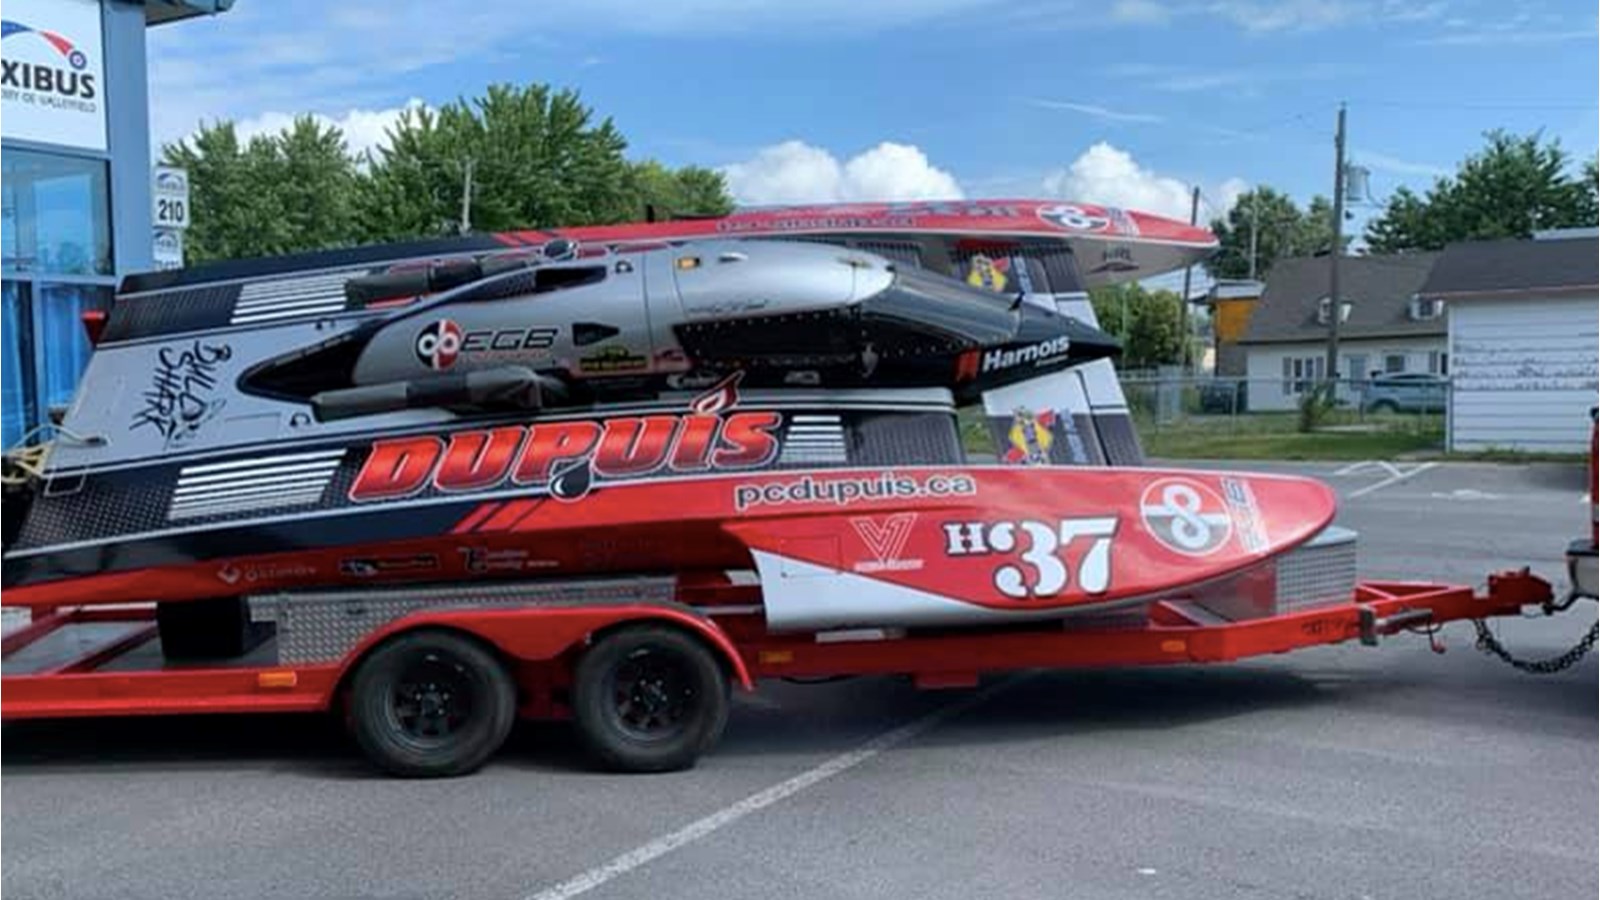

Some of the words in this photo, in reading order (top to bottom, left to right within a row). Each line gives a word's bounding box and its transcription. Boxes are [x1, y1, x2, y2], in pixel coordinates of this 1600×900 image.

[1, 58, 96, 100] XIBUS
[159, 198, 185, 222] 210
[459, 327, 560, 352] EGB
[982, 335, 1070, 373] Harnois
[734, 472, 977, 511] pcdupuis.ca
